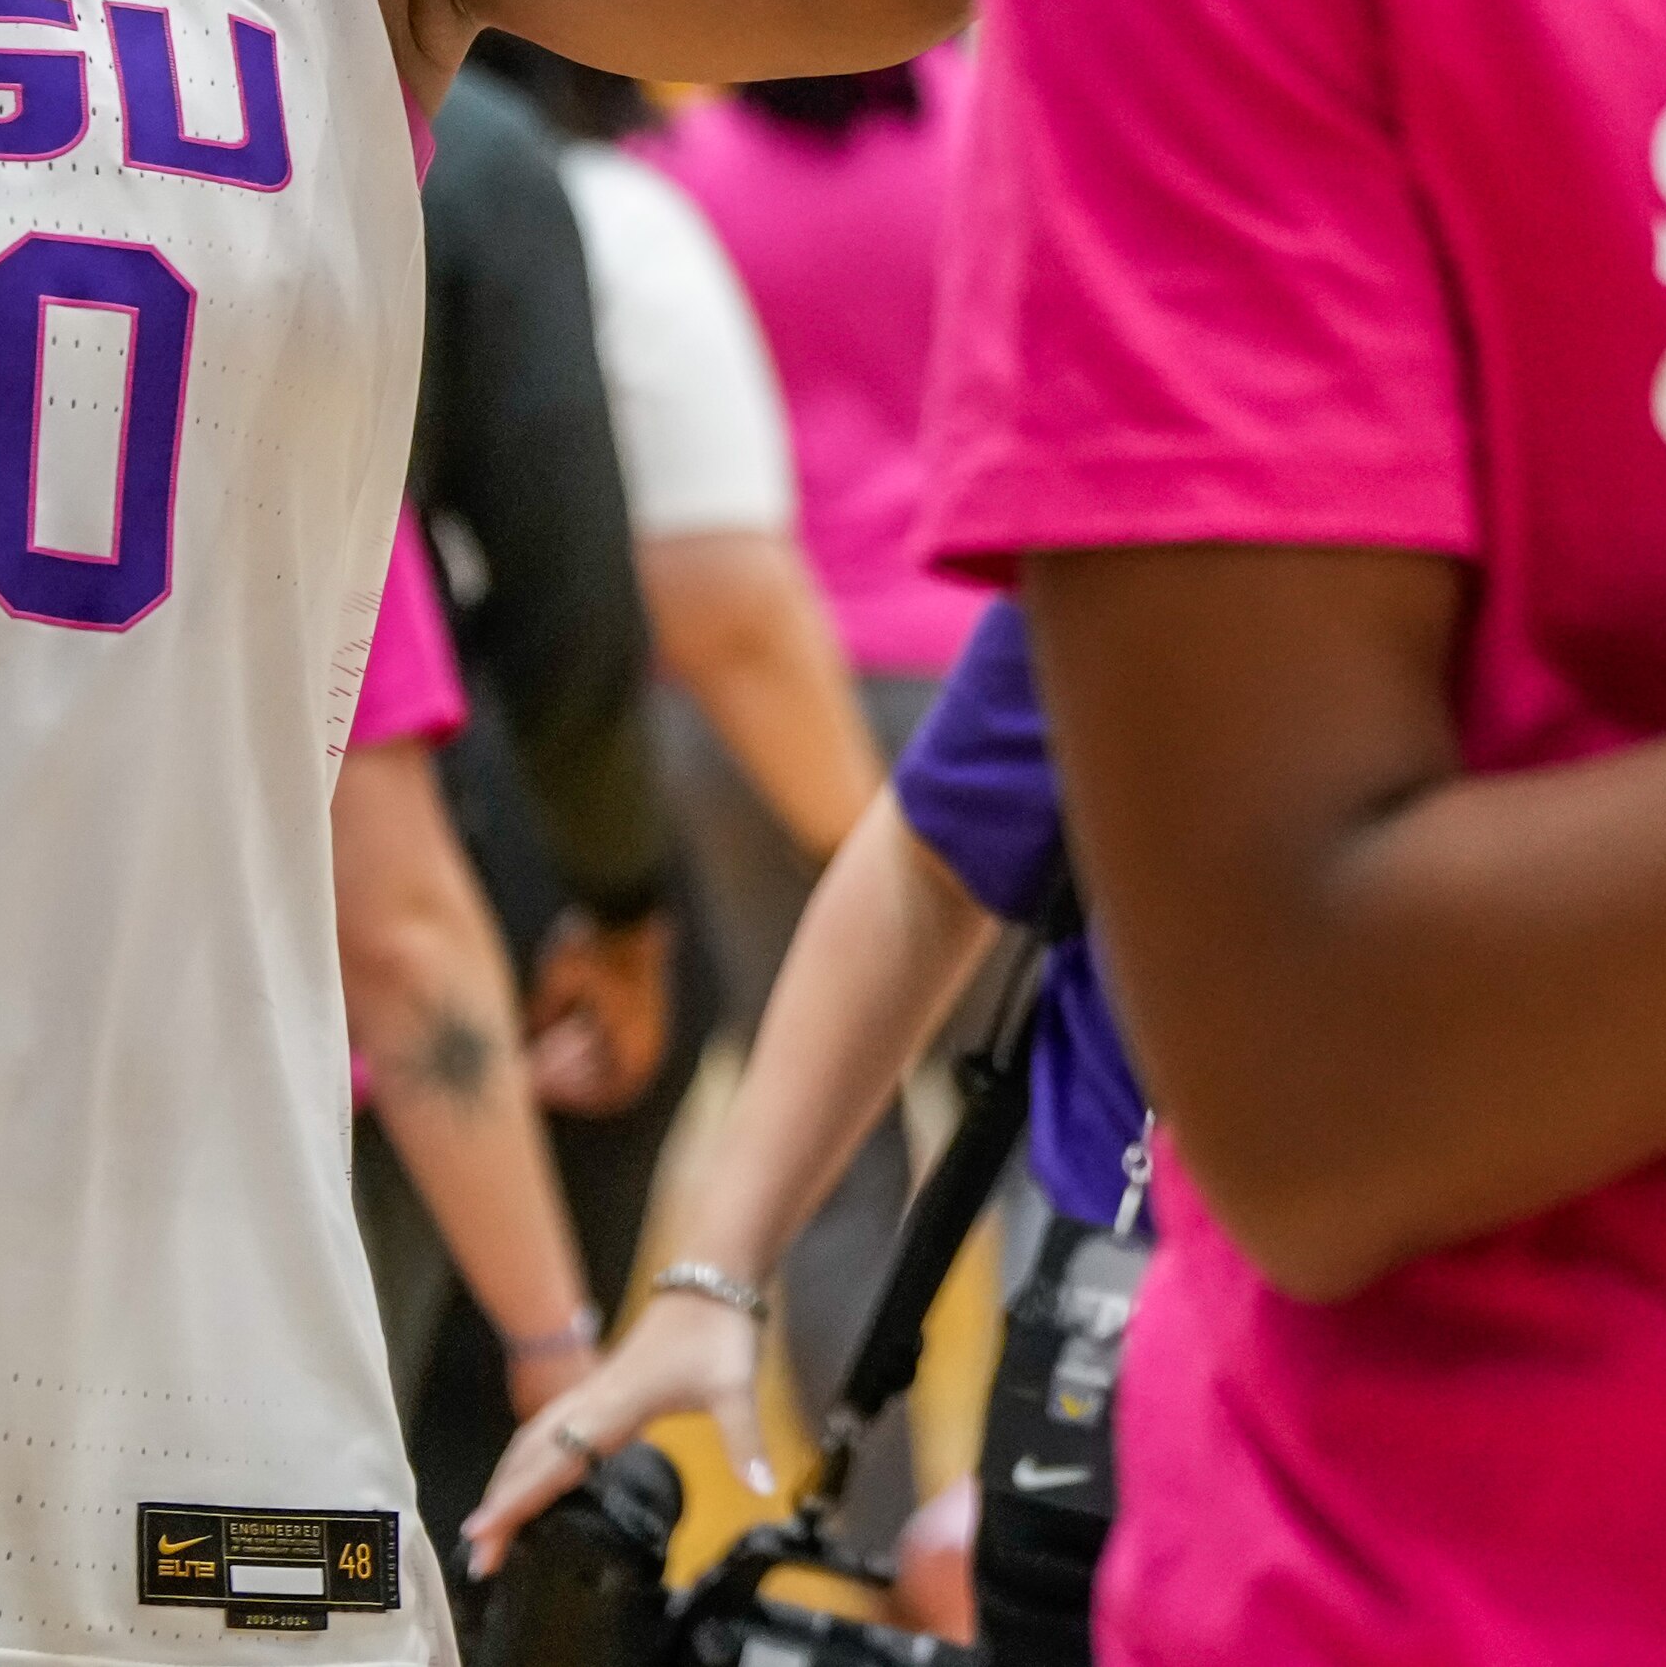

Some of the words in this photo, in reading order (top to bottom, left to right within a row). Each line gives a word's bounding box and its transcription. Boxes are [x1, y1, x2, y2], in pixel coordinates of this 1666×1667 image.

[229, 1522, 321, 1538] ENGINEERED
[157, 1558, 217, 1579] ELITE
[337, 1542, 373, 1580] 48
